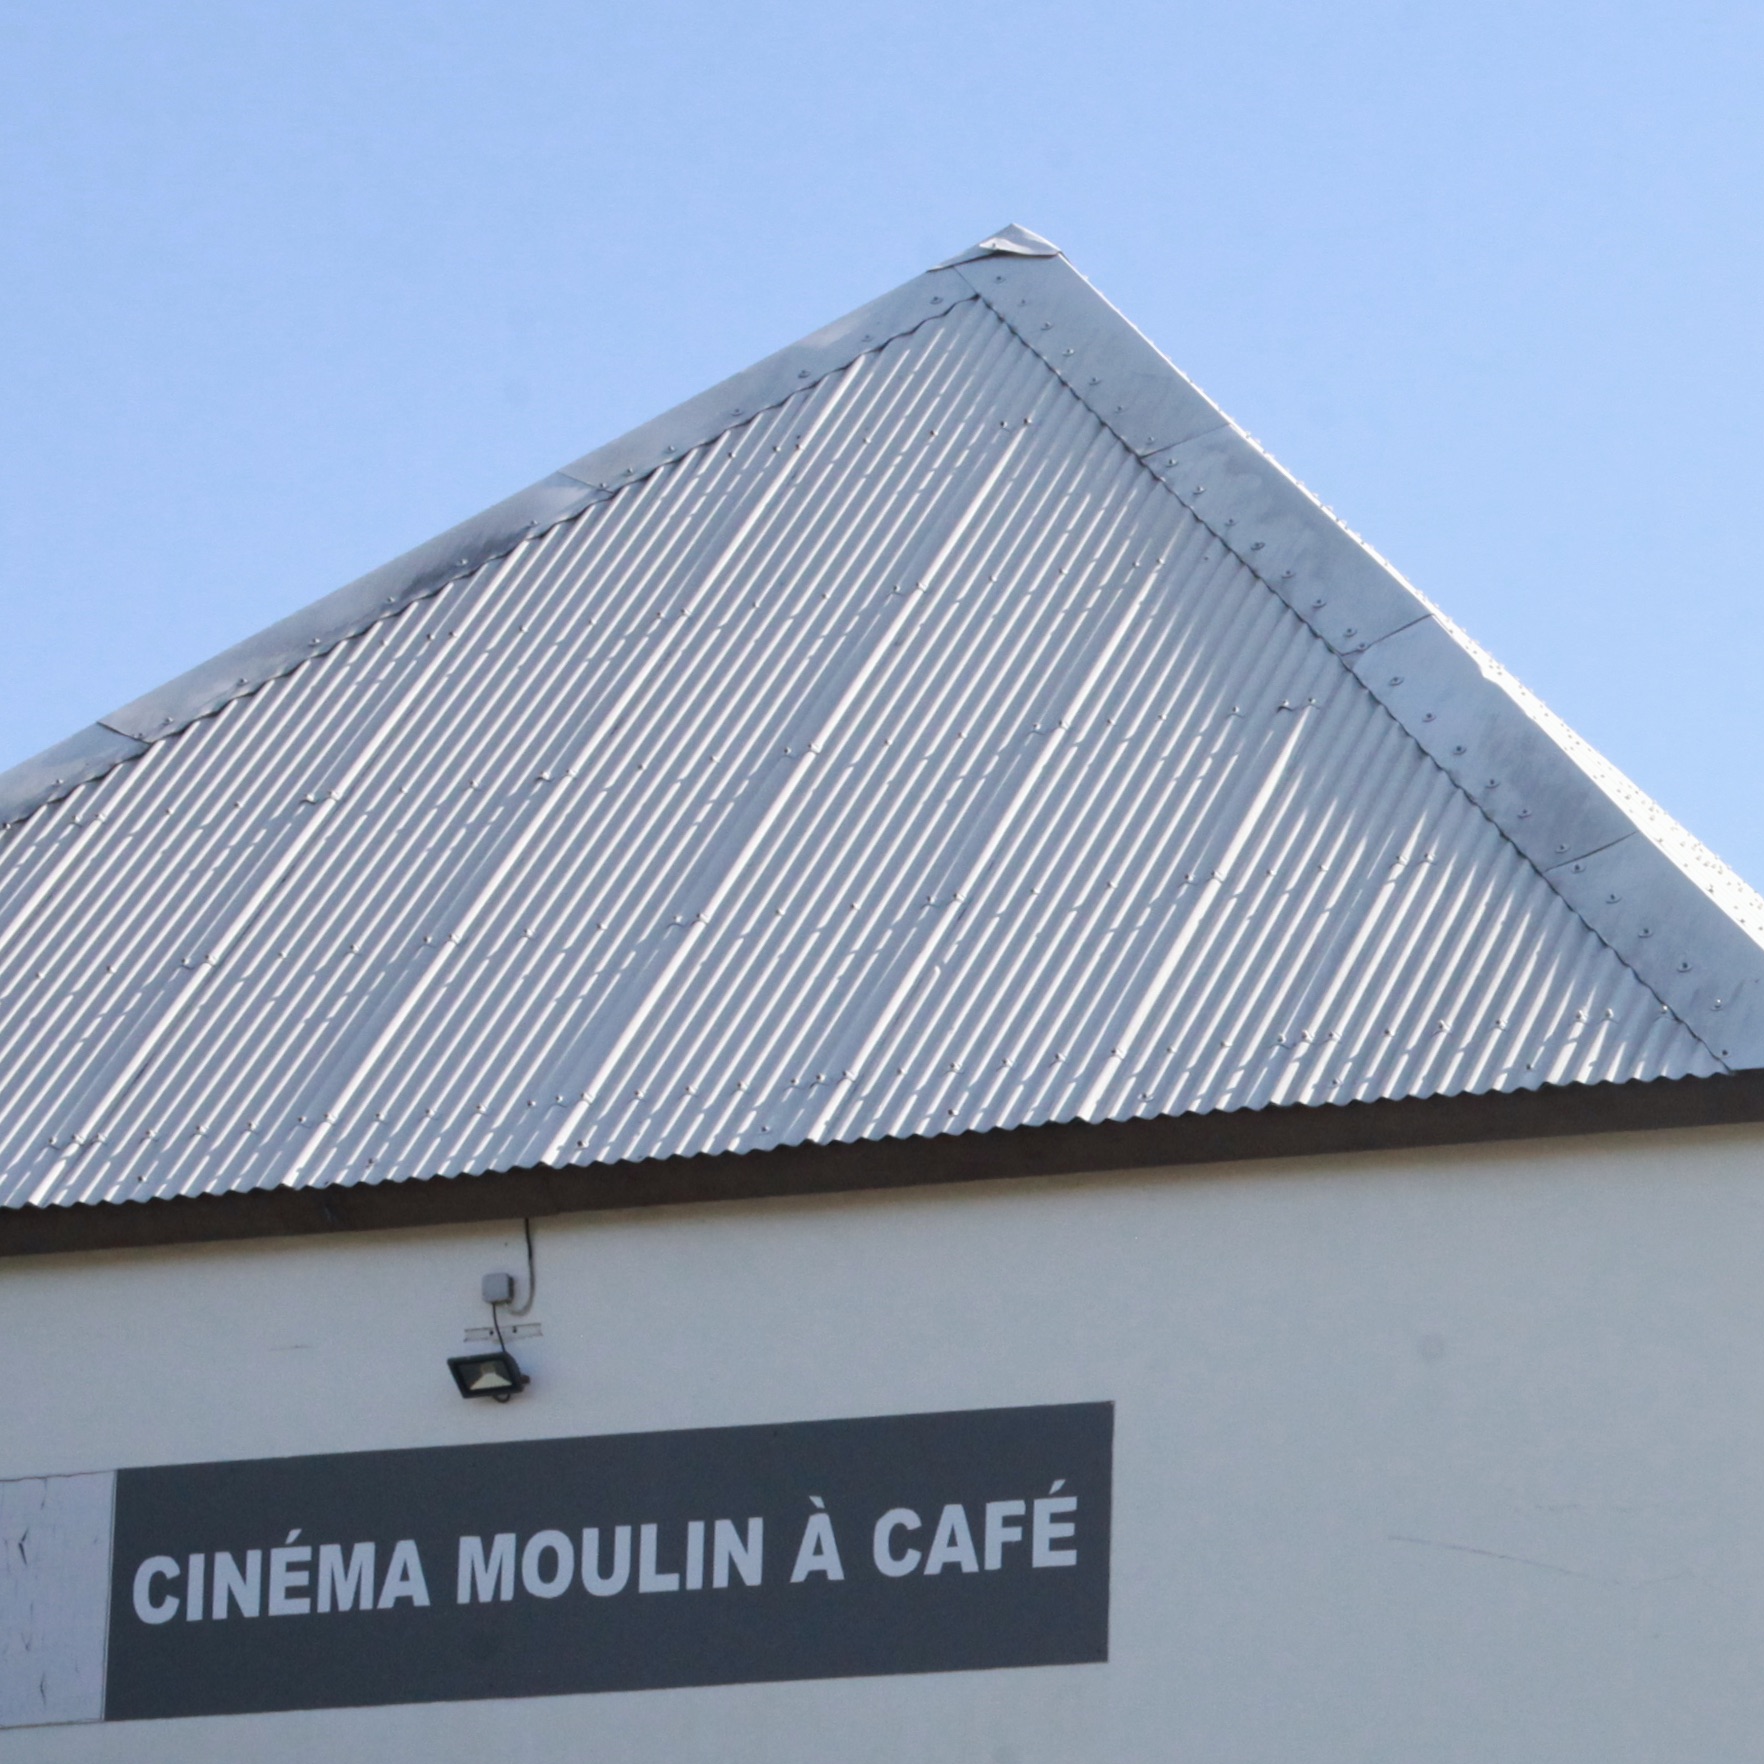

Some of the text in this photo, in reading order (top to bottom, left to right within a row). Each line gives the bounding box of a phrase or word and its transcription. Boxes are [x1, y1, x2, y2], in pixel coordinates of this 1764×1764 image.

[133, 1479, 1077, 1624] CINÉMA MOULIN À CAFÉ
